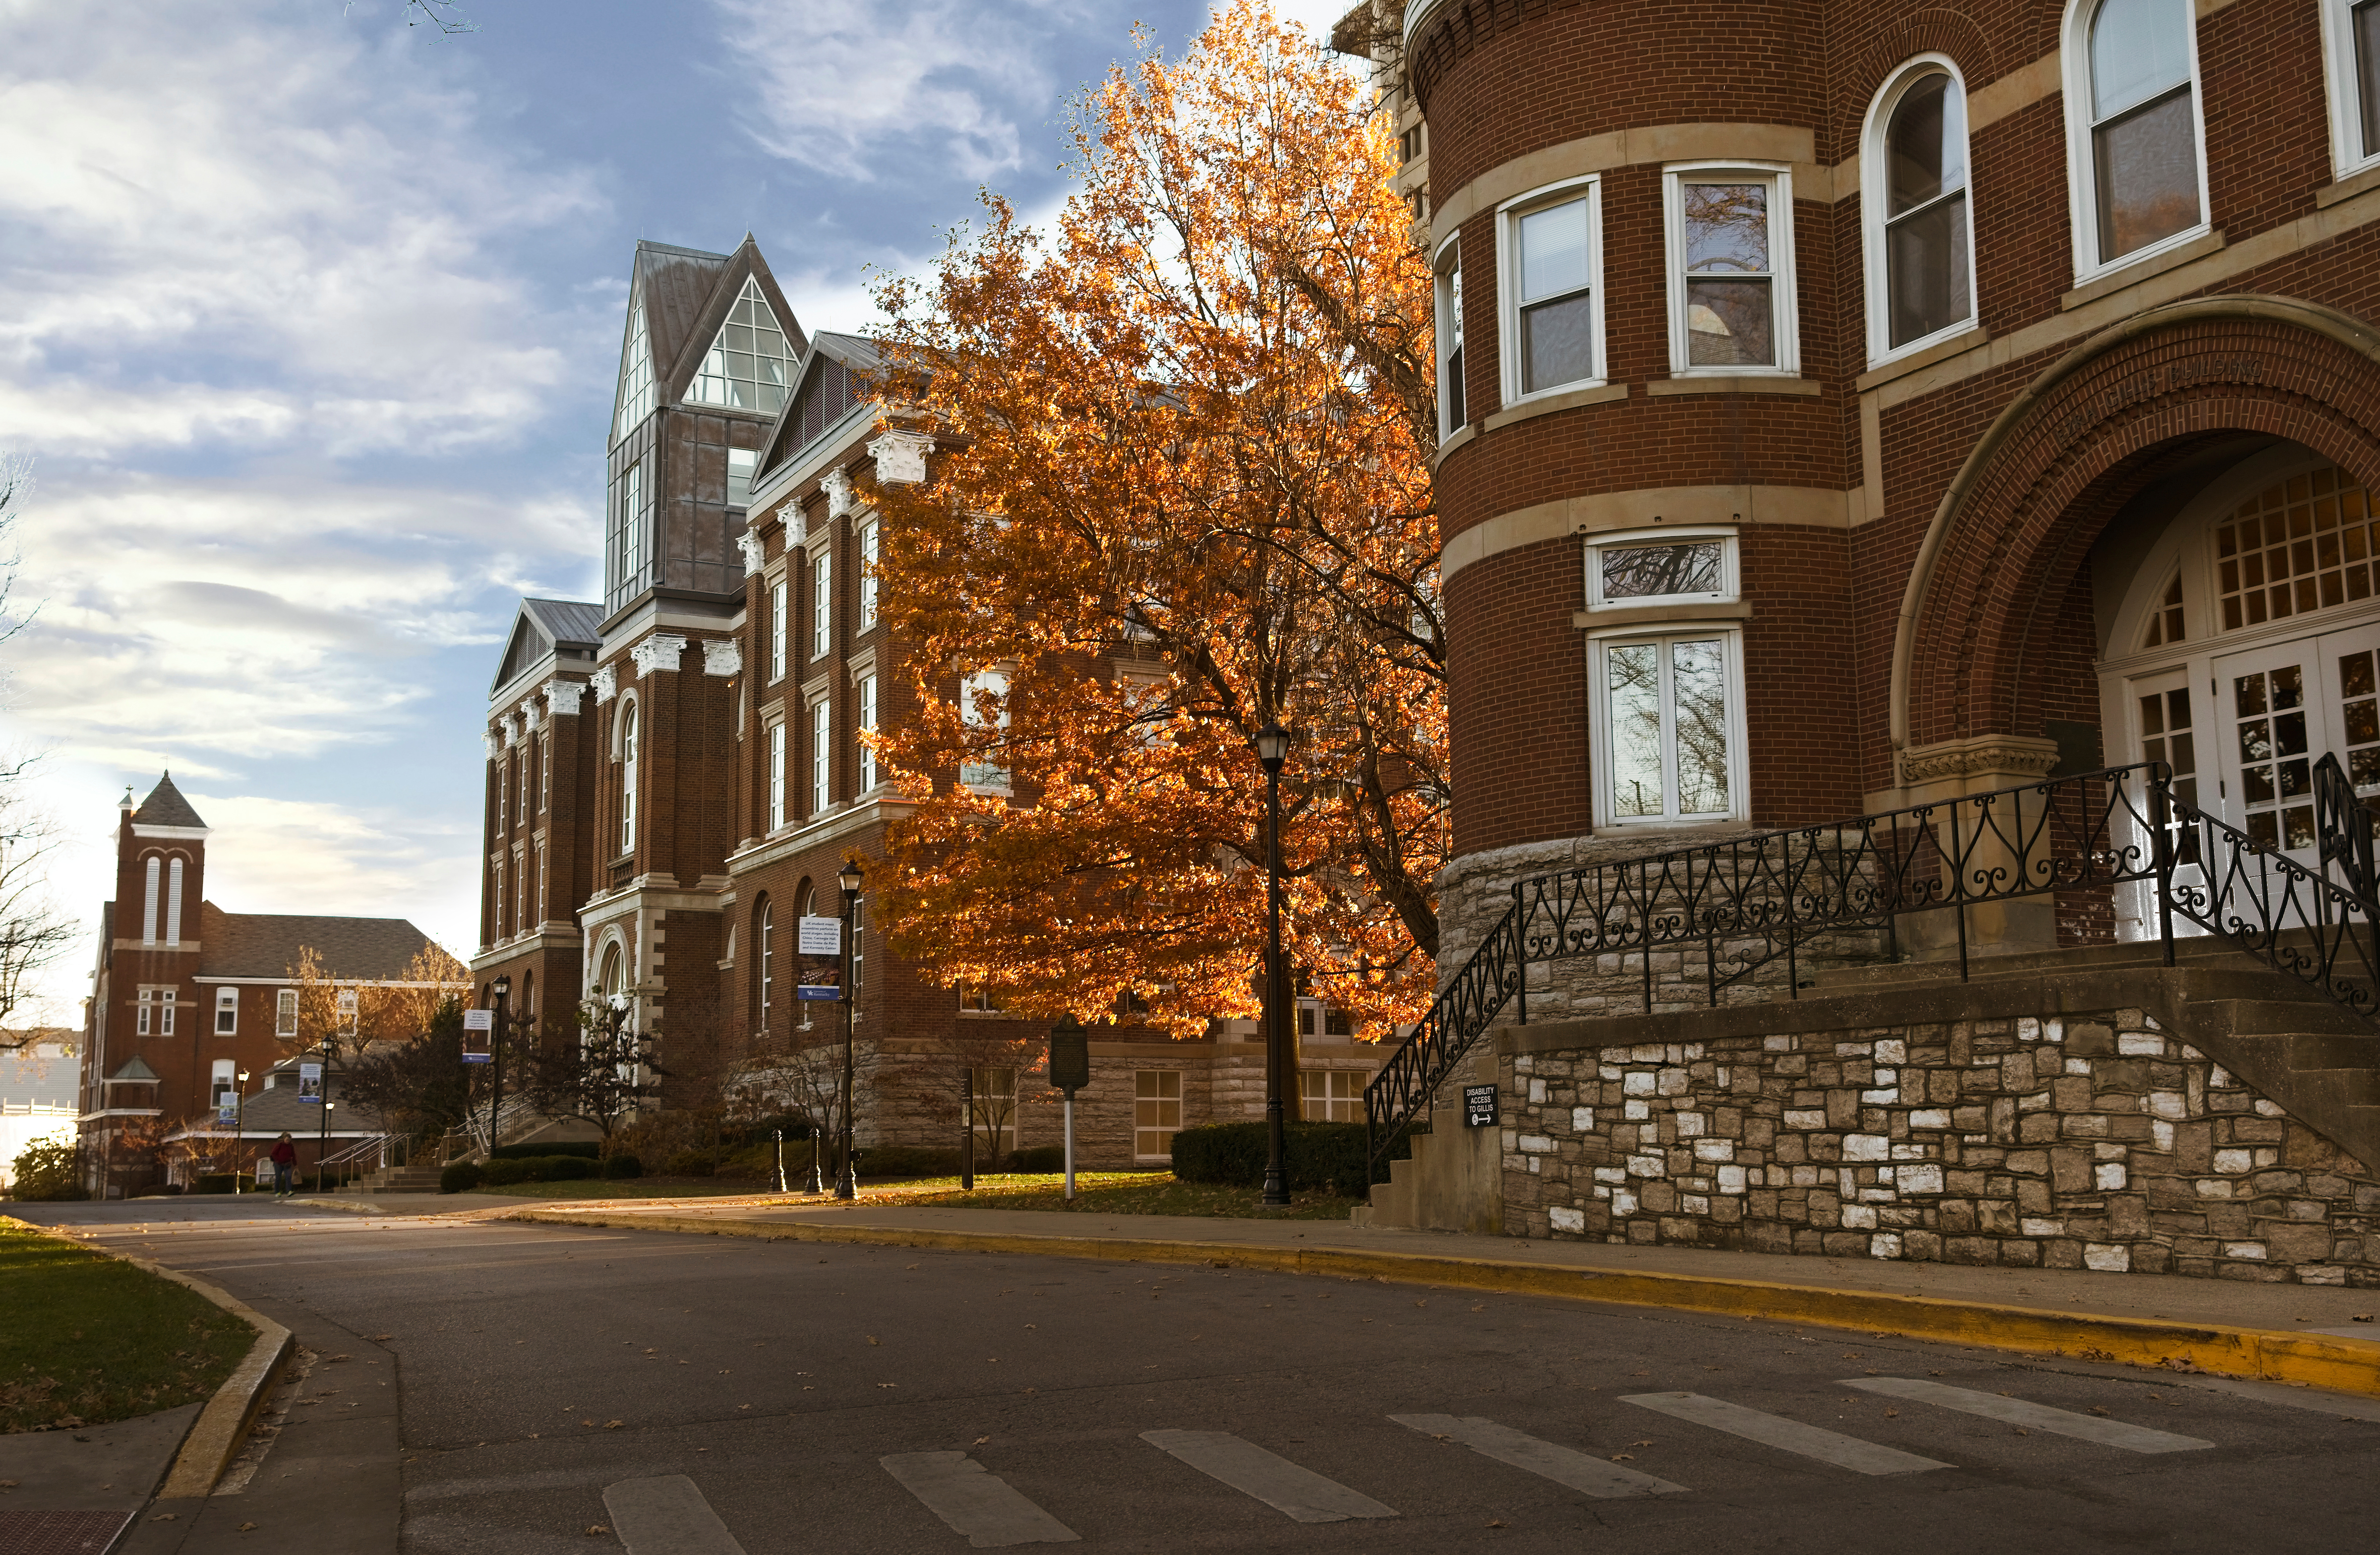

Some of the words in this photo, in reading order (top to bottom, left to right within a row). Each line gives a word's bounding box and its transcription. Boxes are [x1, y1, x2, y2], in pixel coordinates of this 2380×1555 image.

[2057, 406, 2097, 444] EZRA
[2107, 373, 2156, 407] GILLIS
[2170, 359, 2263, 383] BUILDING
[1467, 1087, 1494, 1096] DISABILITY
[1470, 1095, 1491, 1104] ACCESS
